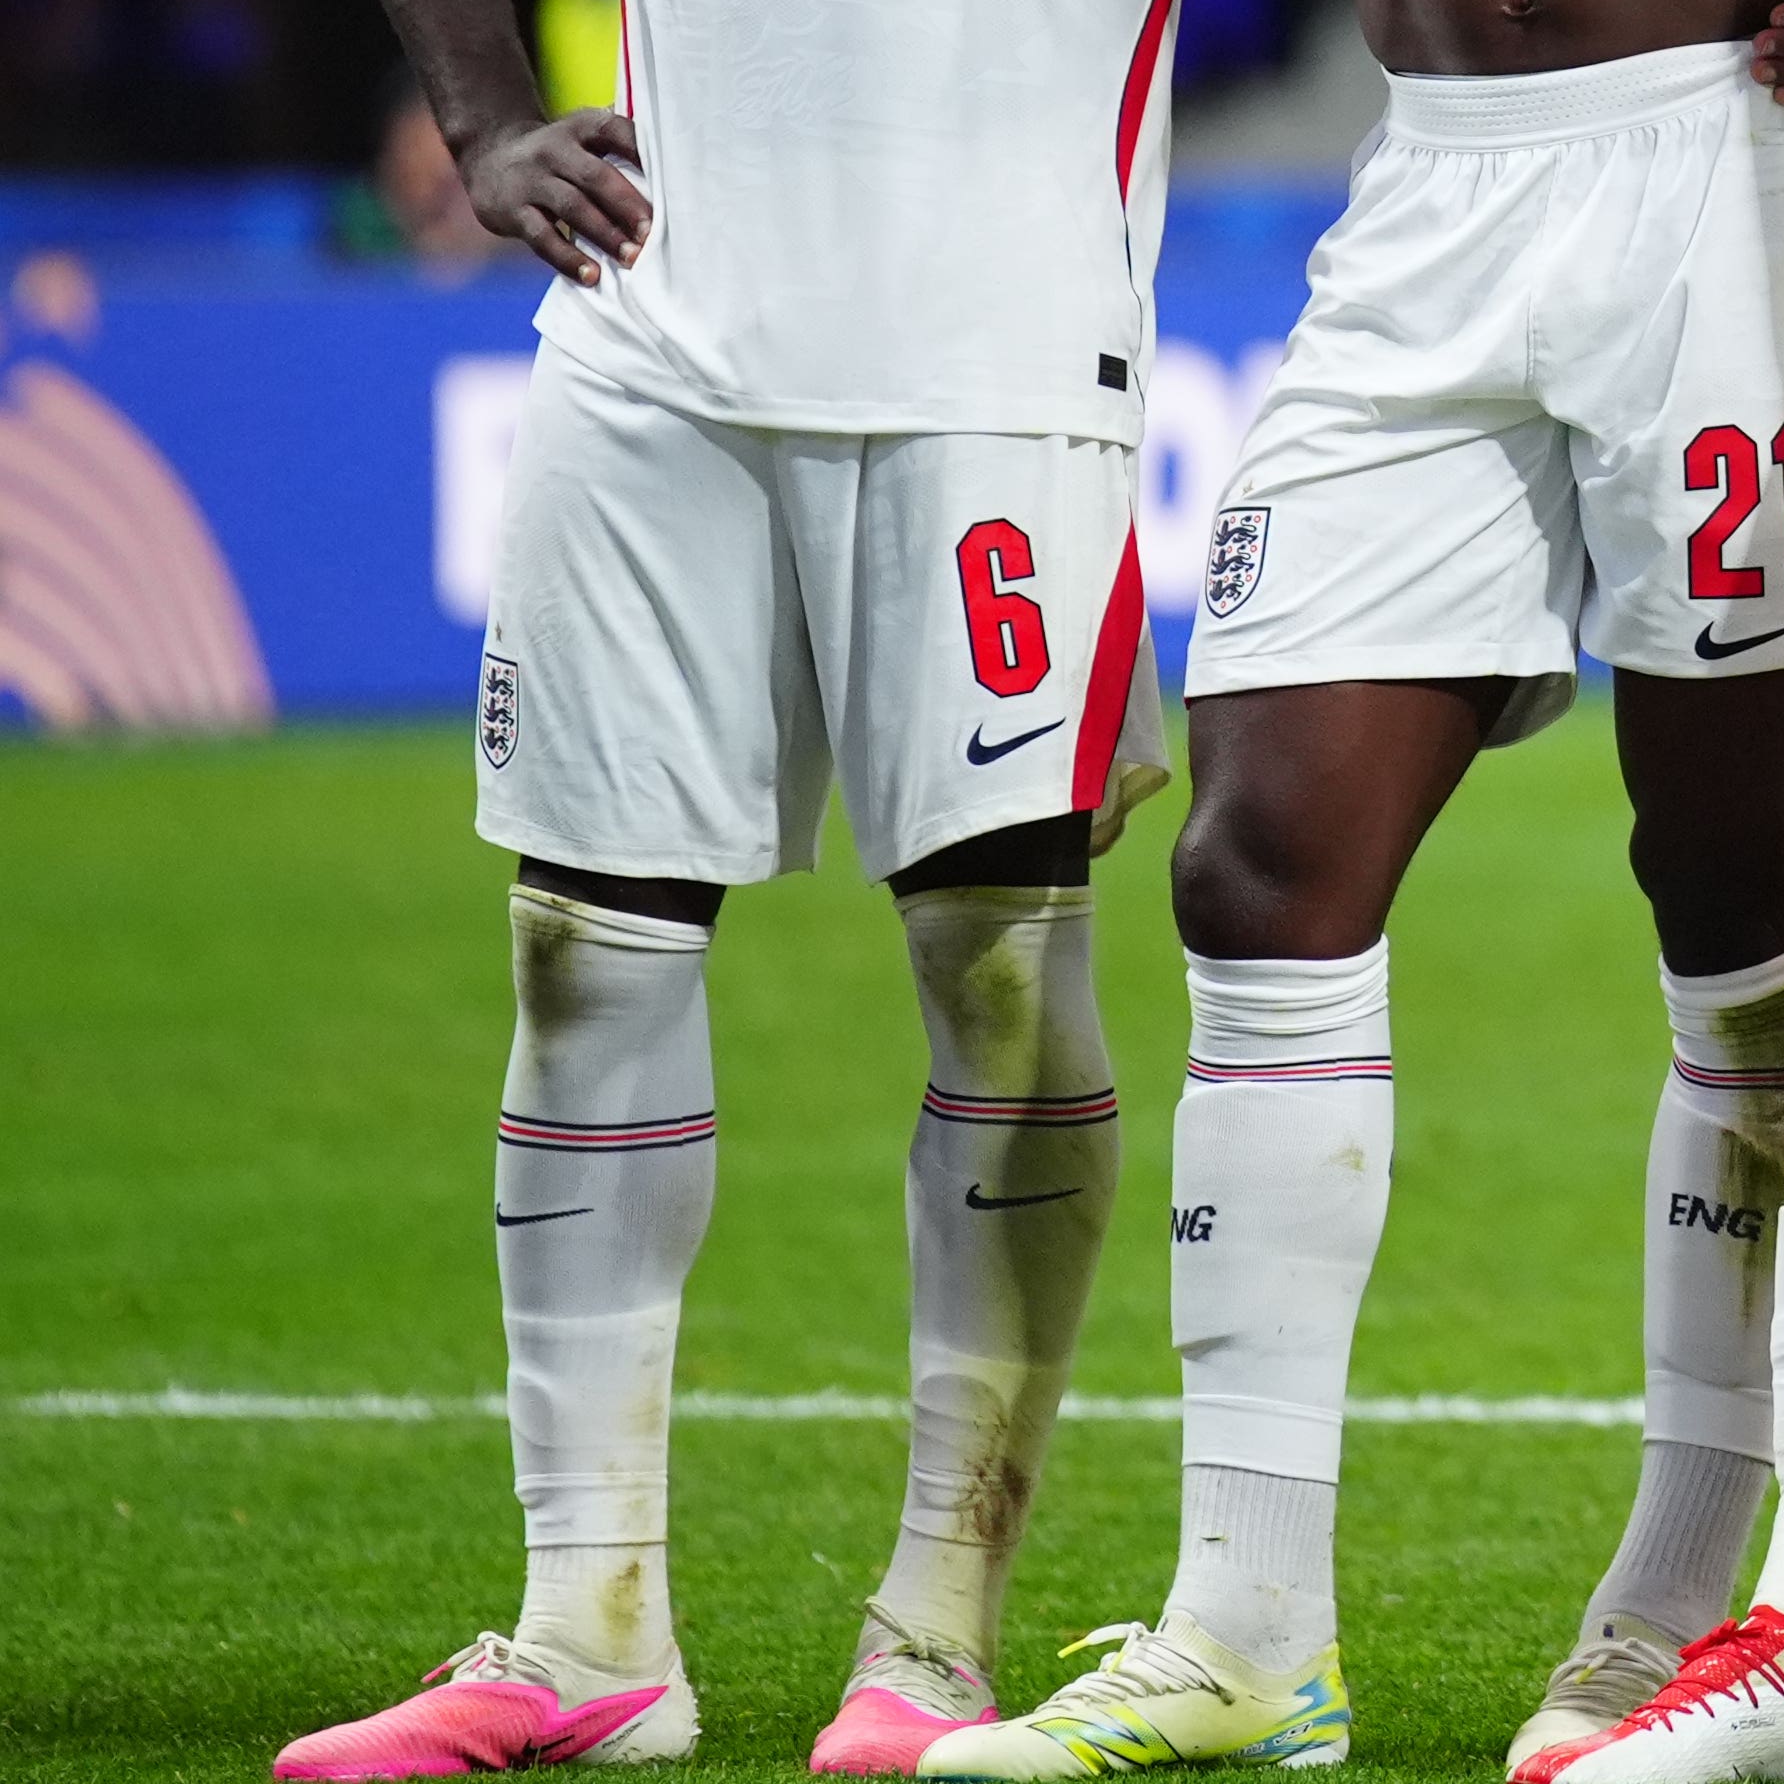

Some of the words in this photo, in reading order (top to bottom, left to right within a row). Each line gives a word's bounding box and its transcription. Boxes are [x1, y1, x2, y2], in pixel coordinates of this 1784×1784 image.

[955, 517, 1052, 700] 6
[1170, 1205, 1217, 1244] NG
[1669, 1193, 1765, 1242] ENG
